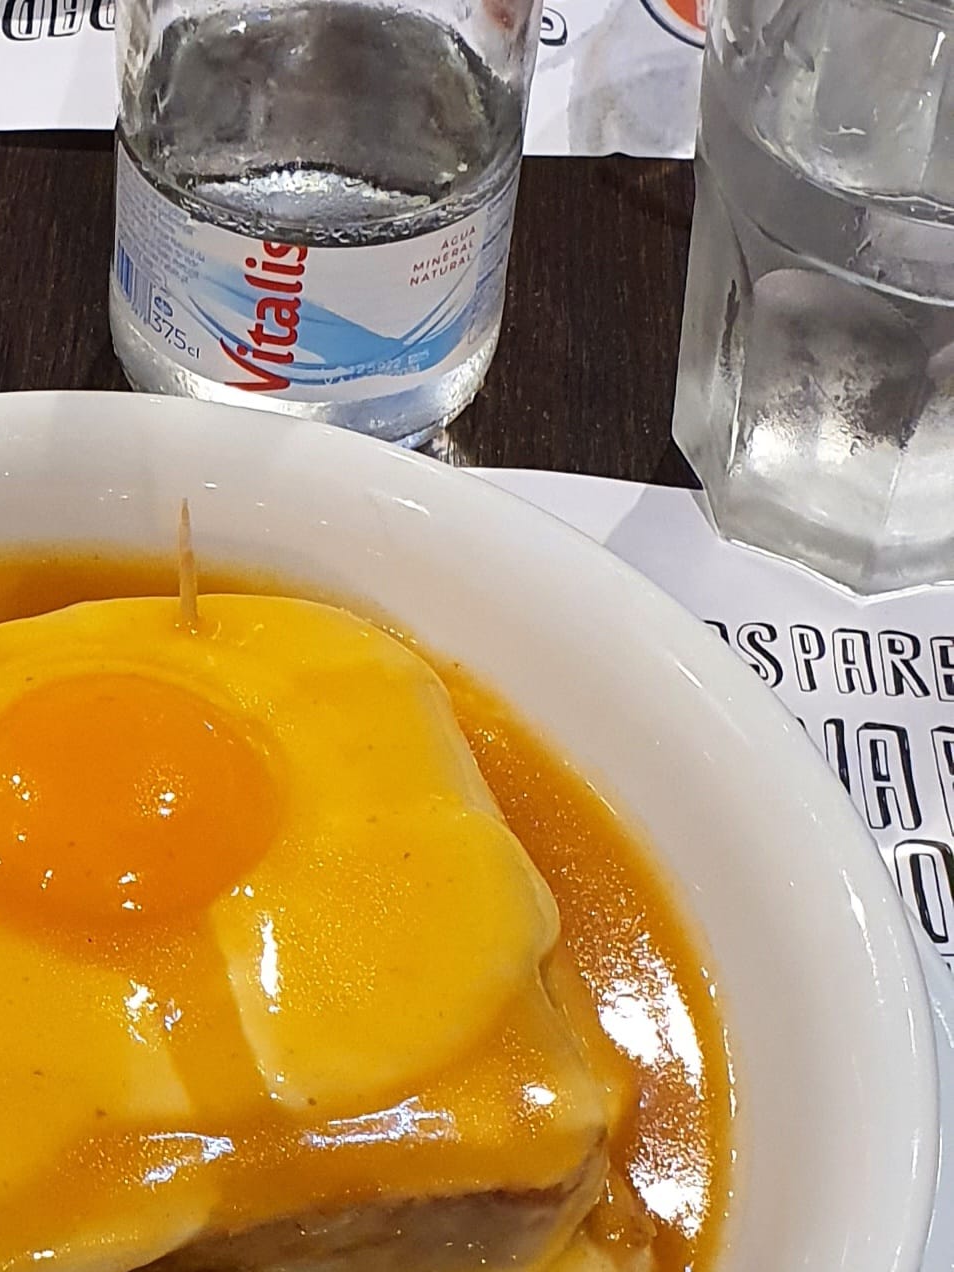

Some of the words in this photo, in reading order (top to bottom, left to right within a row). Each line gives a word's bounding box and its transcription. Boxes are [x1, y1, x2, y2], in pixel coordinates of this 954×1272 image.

[409, 254, 472, 288] NATURAL
[413, 239, 475, 273] MINERAL
[219, 240, 309, 392] Vitalis
